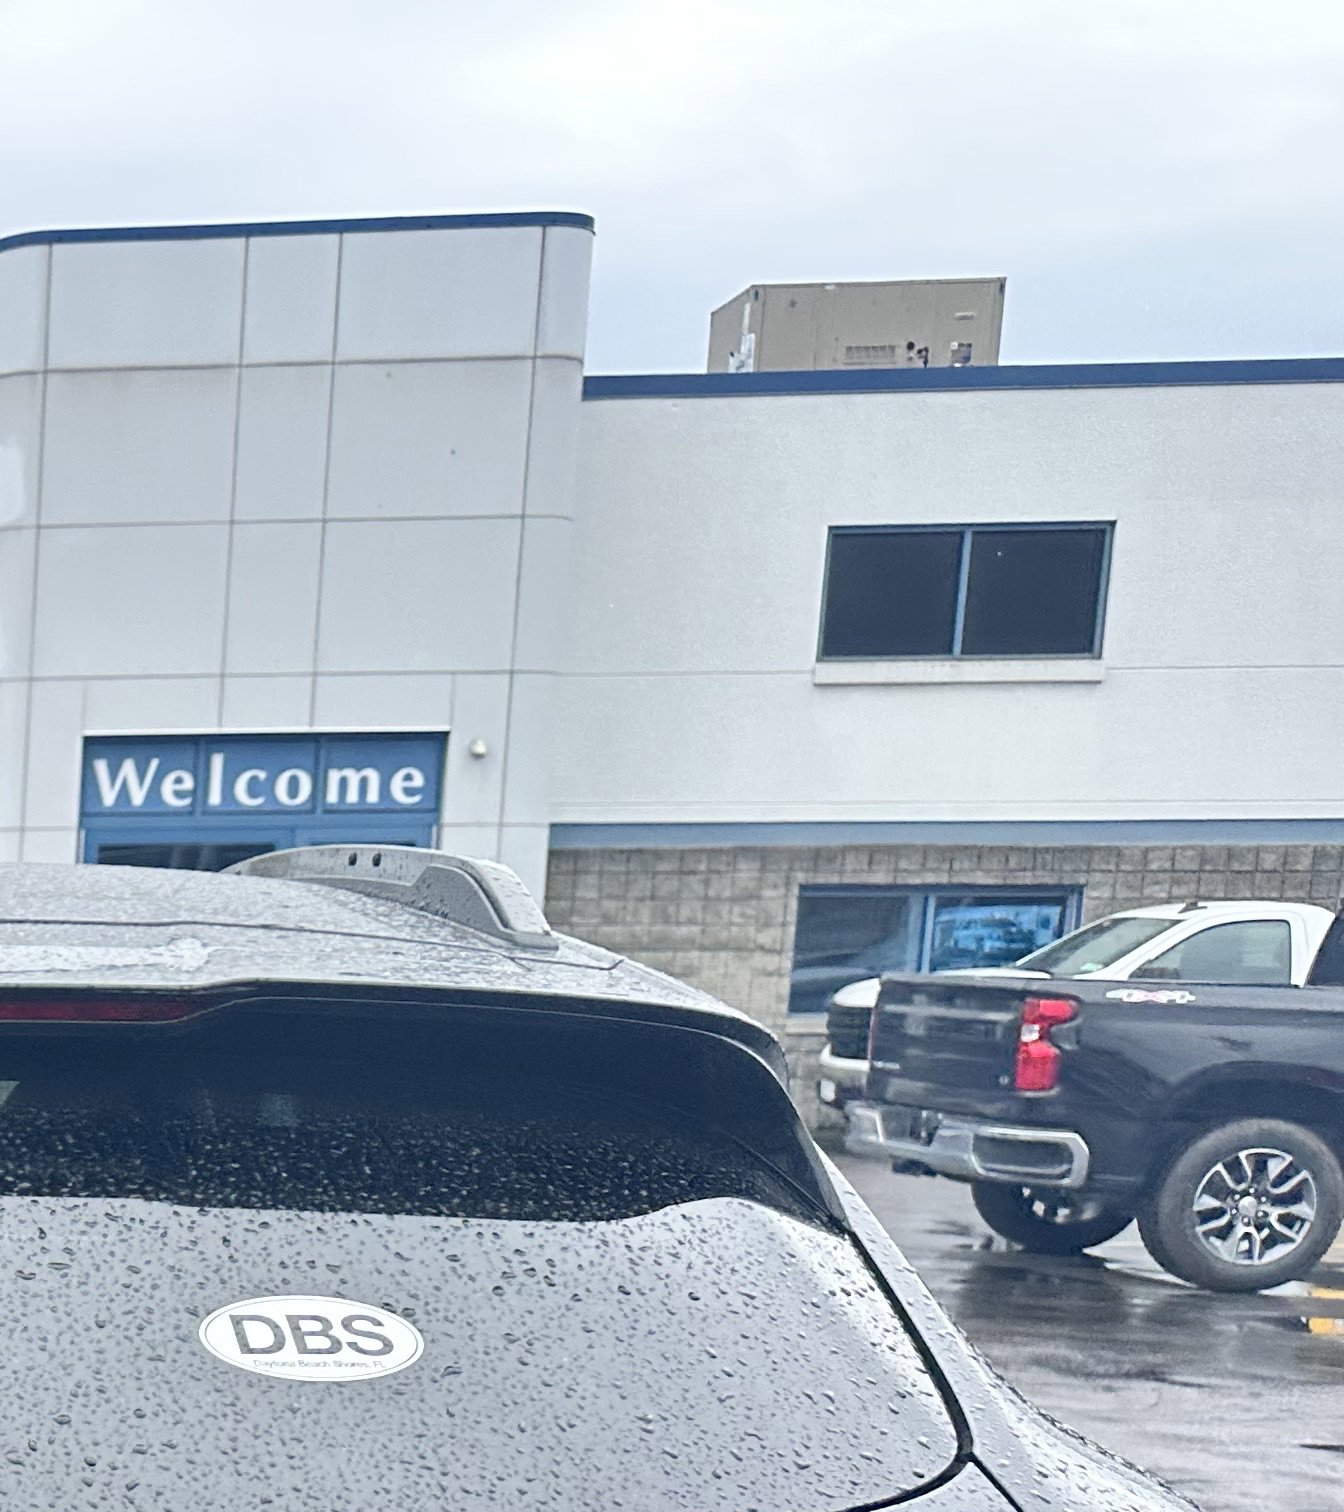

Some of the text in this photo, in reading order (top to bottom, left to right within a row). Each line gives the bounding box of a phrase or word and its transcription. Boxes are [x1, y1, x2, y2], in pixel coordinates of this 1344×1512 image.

[93, 752, 425, 807] Welcome
[228, 1313, 395, 1357] DBS
[298, 1359, 330, 1368] Beach
